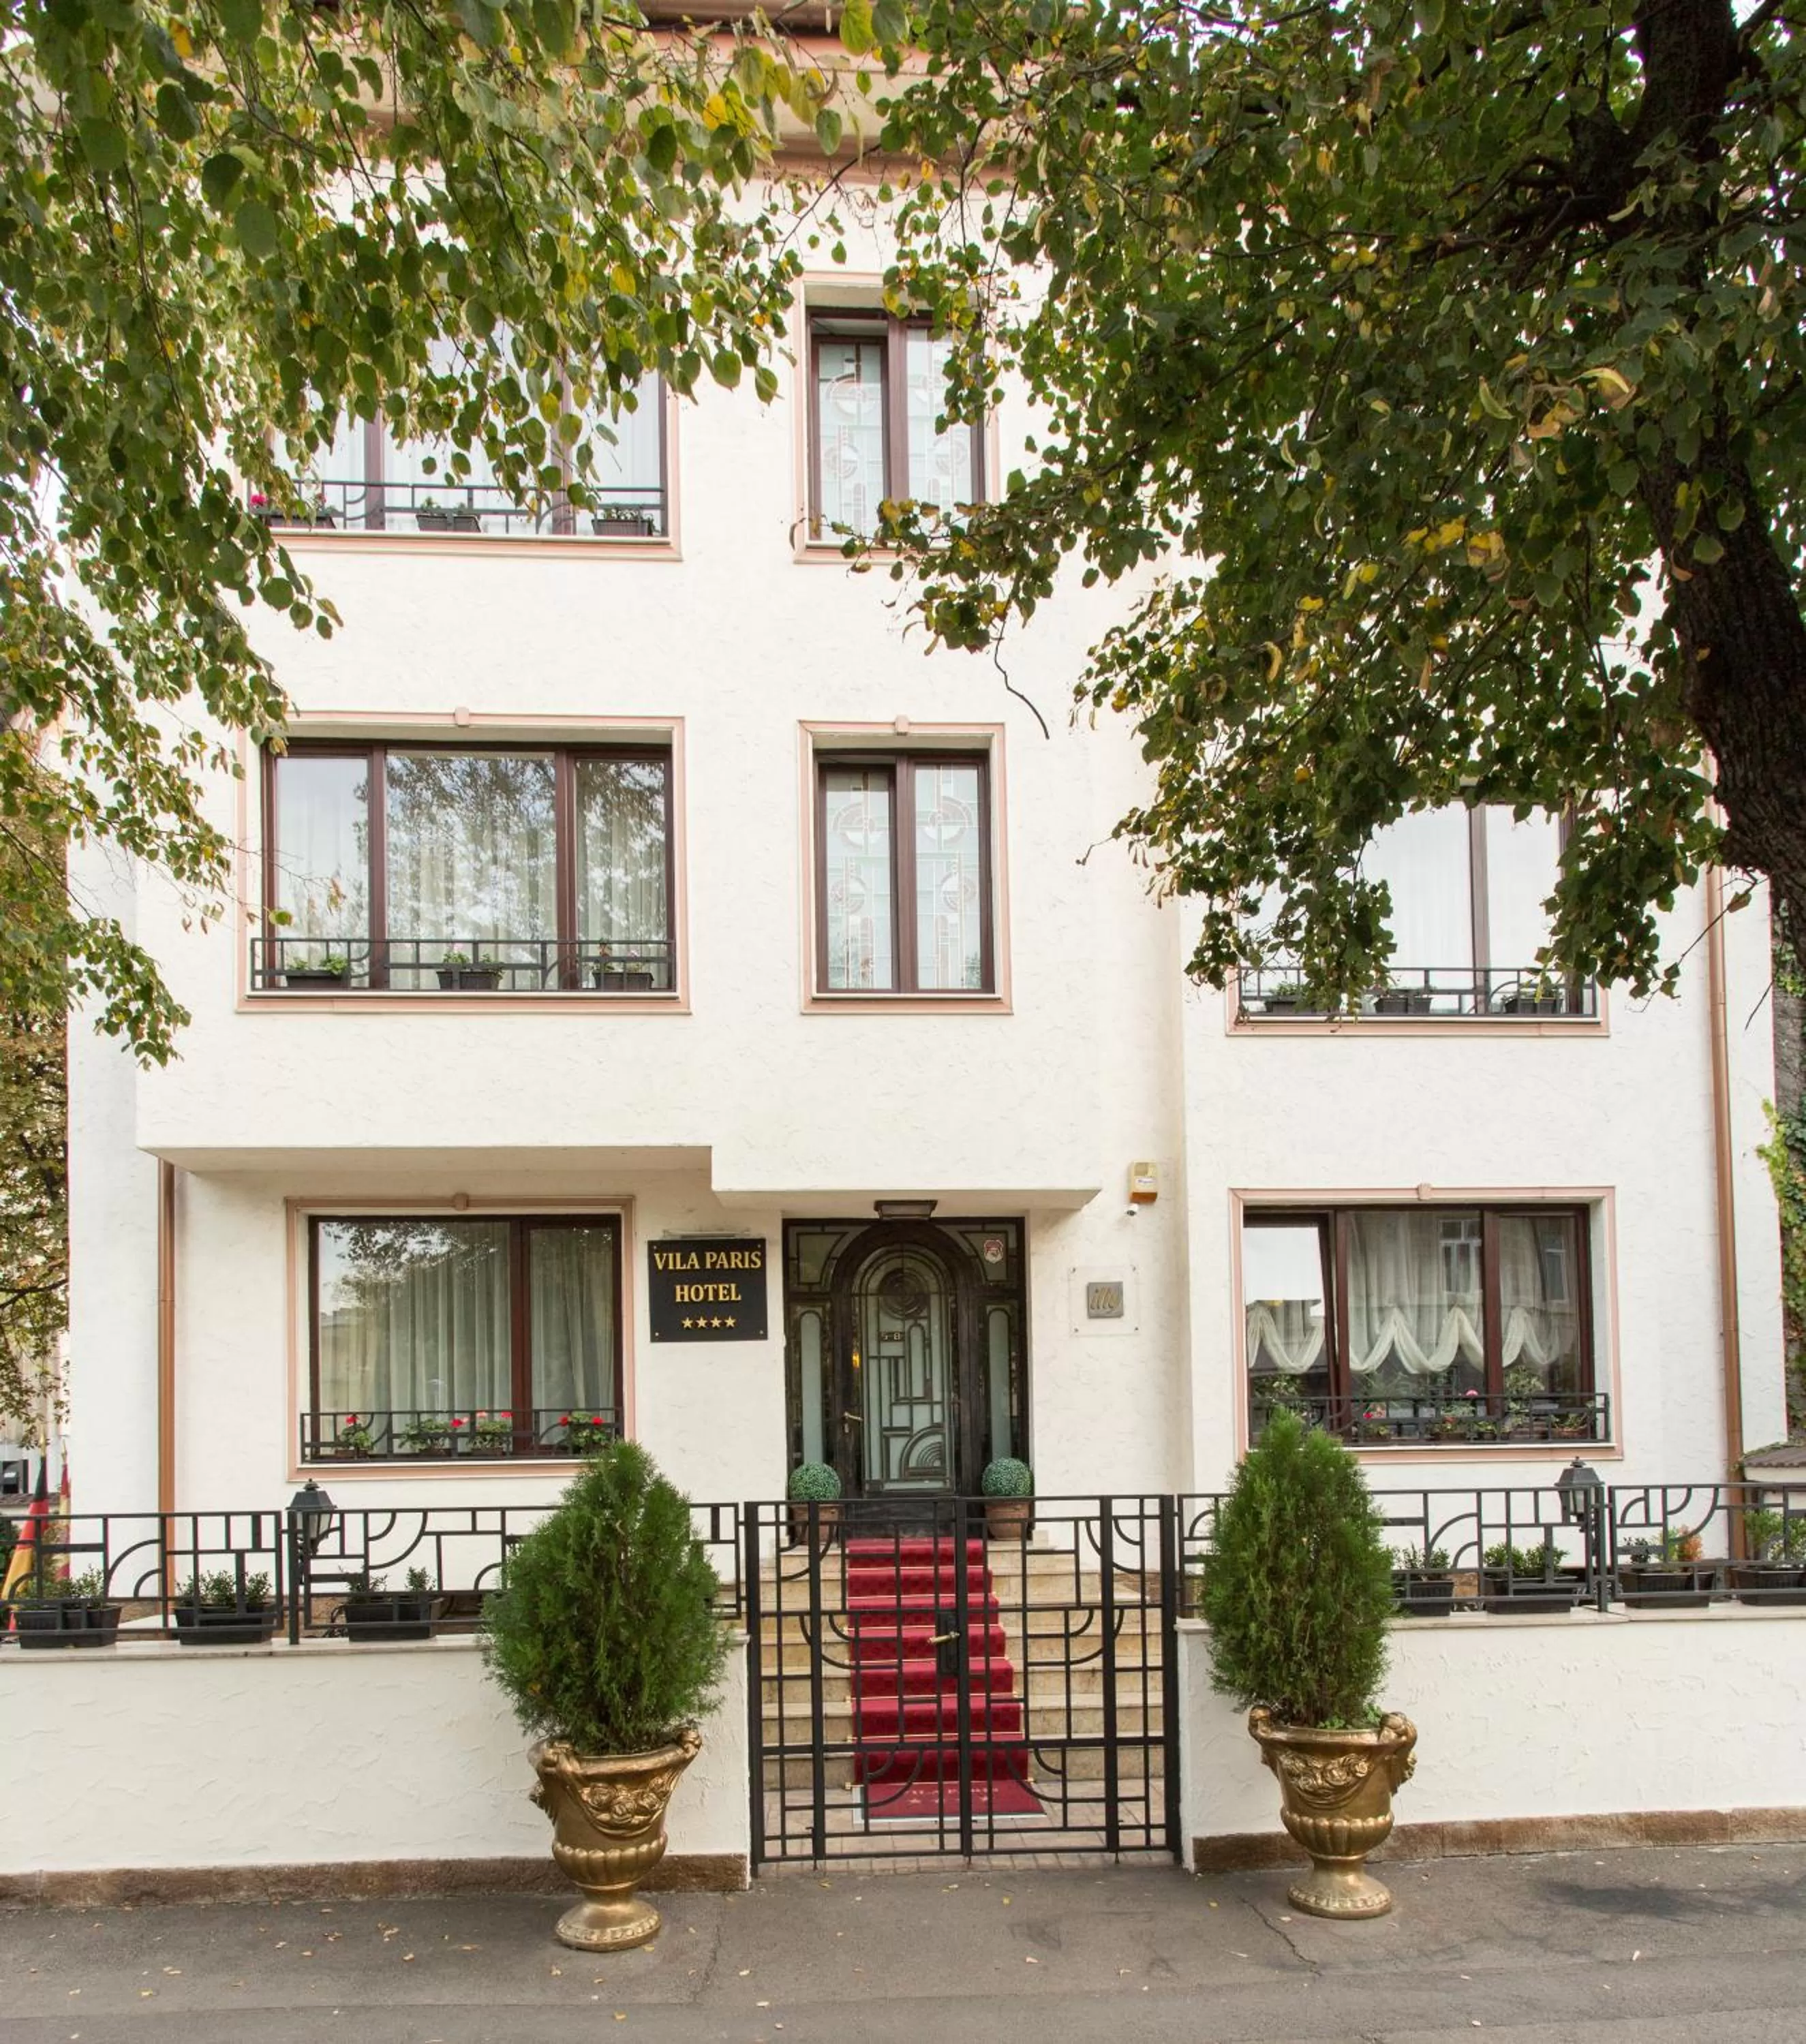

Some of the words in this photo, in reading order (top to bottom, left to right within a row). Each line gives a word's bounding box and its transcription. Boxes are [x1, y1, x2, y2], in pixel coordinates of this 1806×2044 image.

[654, 1252, 700, 1270] VILA
[705, 1251, 761, 1269] PARIS
[675, 1283, 741, 1302] HOTEL
